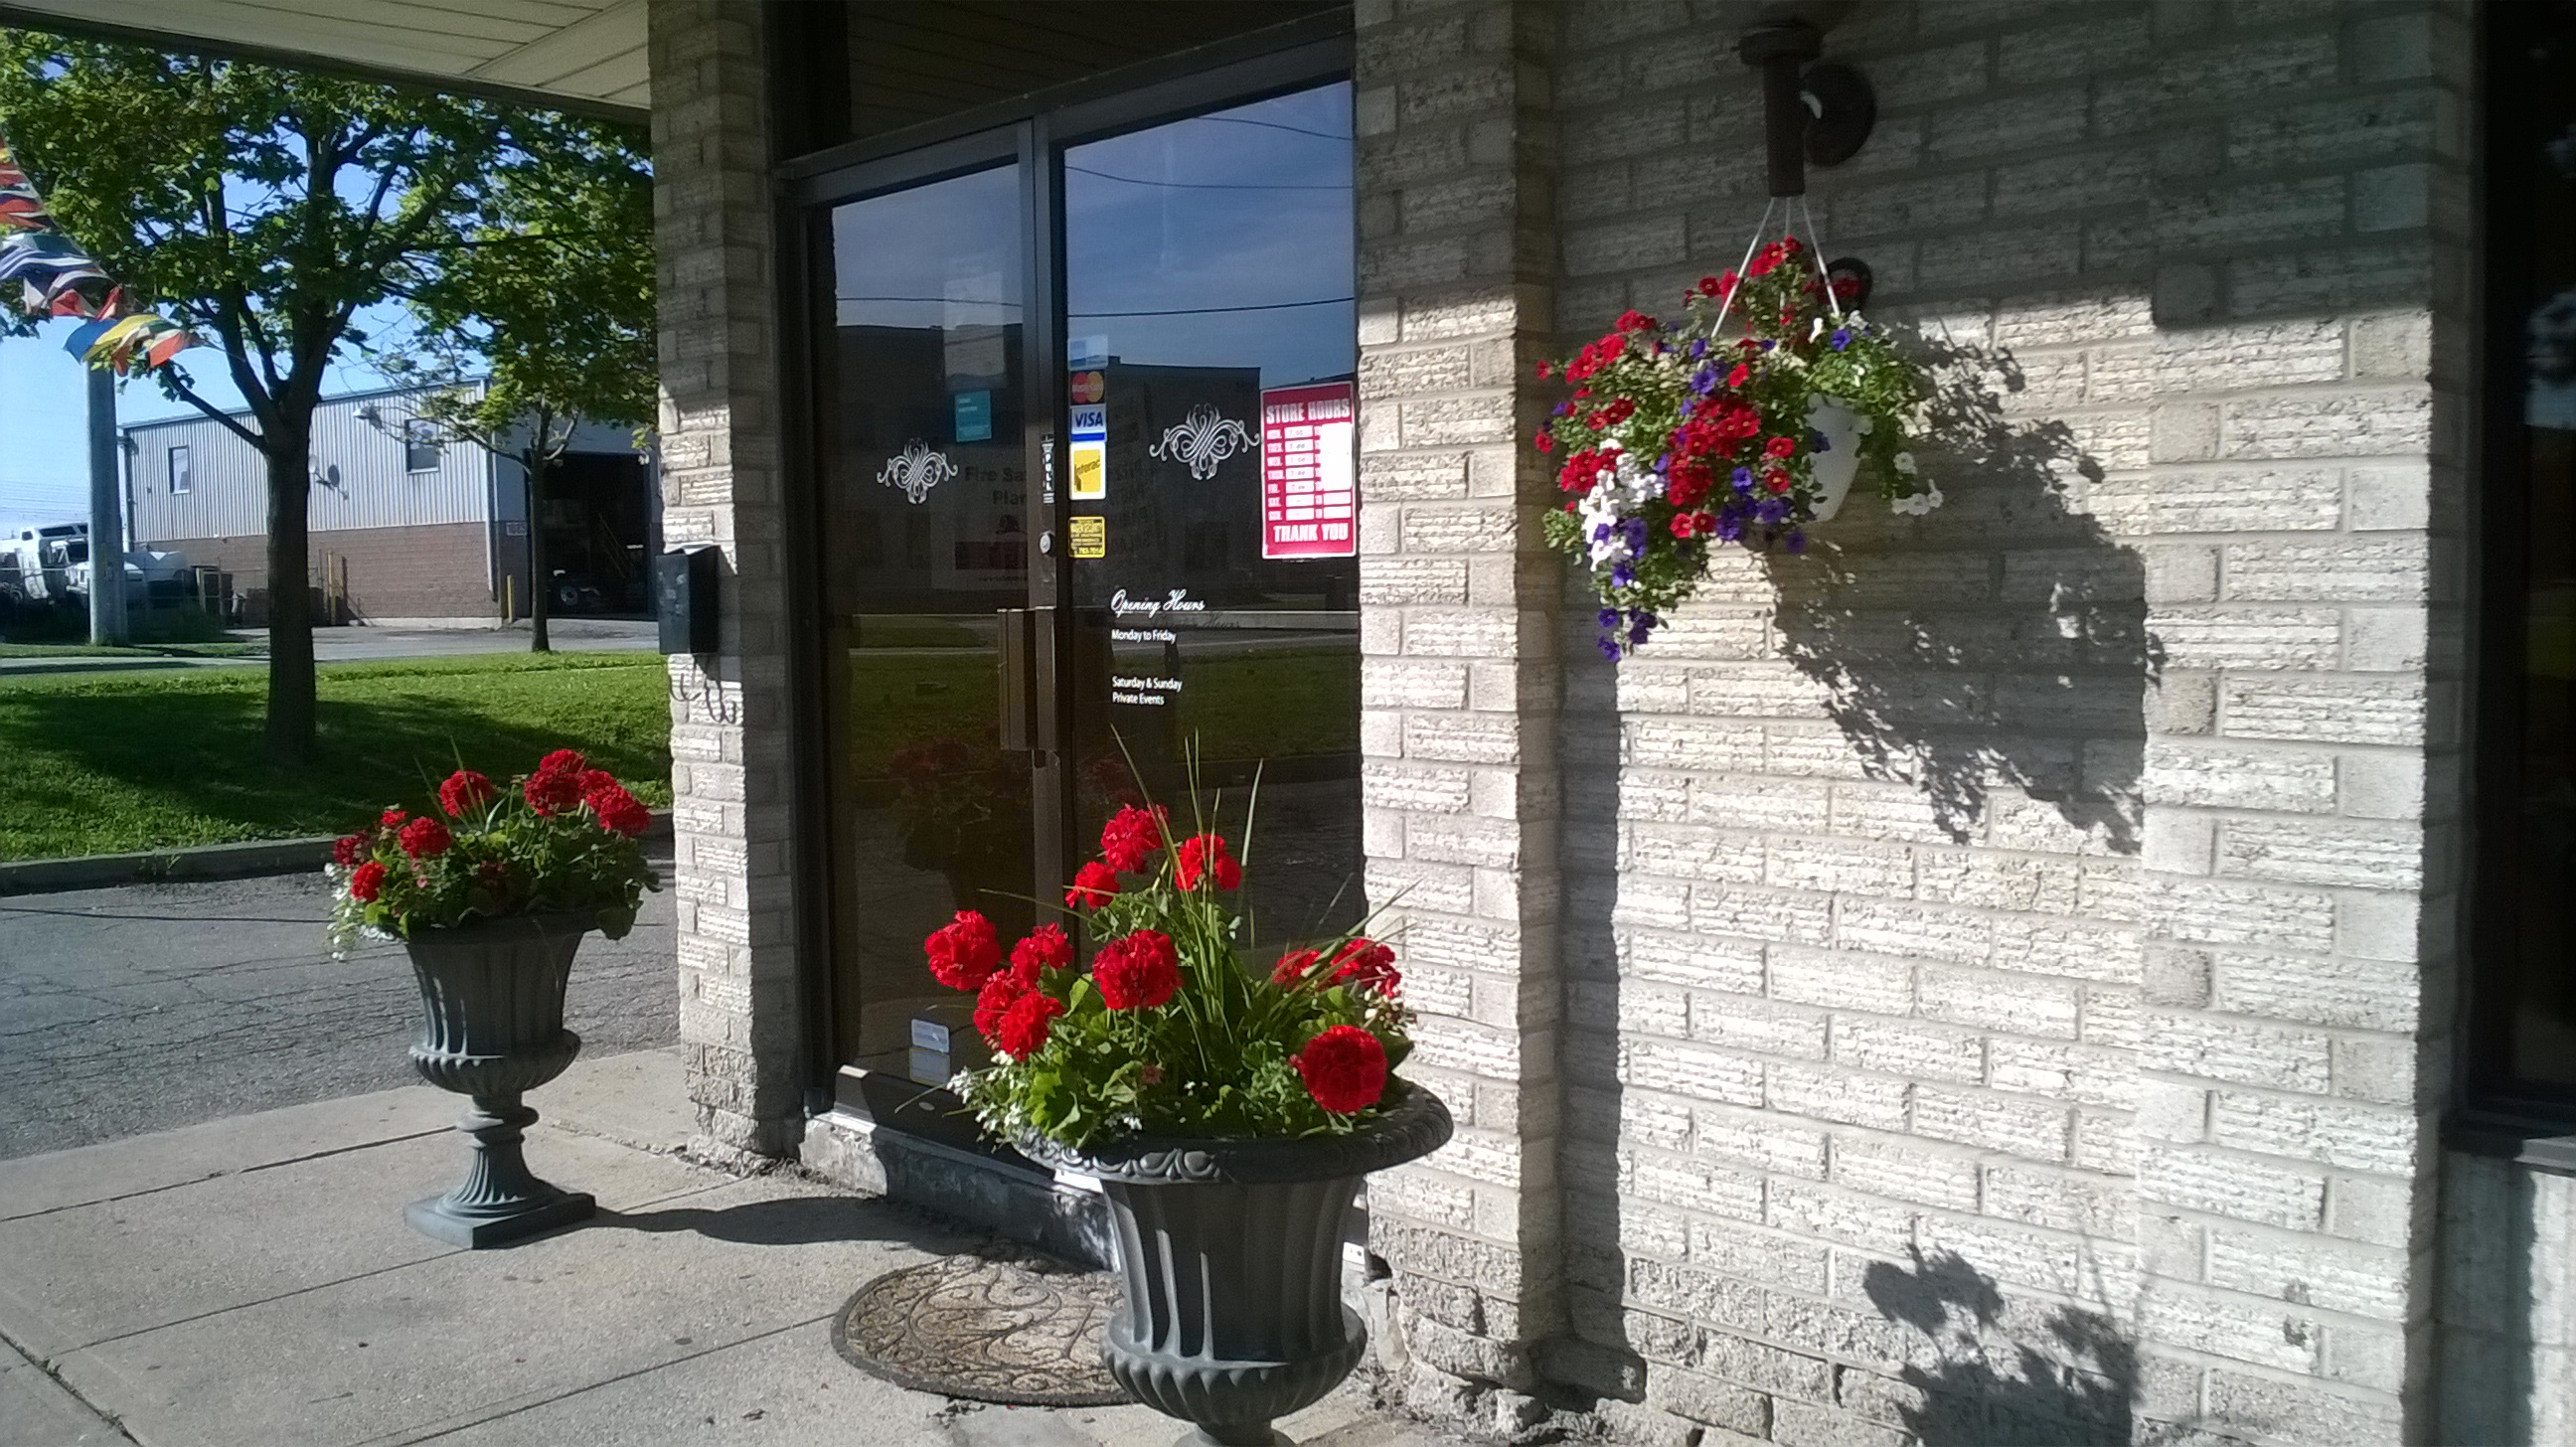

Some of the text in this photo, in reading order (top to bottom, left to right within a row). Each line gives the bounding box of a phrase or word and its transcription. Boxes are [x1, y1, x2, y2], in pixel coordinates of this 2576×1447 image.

[1075, 411, 1103, 427] VISA
[1266, 398, 1350, 424] STORE HOURS
[1273, 523, 1349, 542] THANK YOU
[1111, 588, 1206, 618] Opening Hours
[1111, 628, 1177, 645] Monday to Friday
[1112, 676, 1183, 693] Saturday & Sunday
[1112, 691, 1165, 706] Private Events
